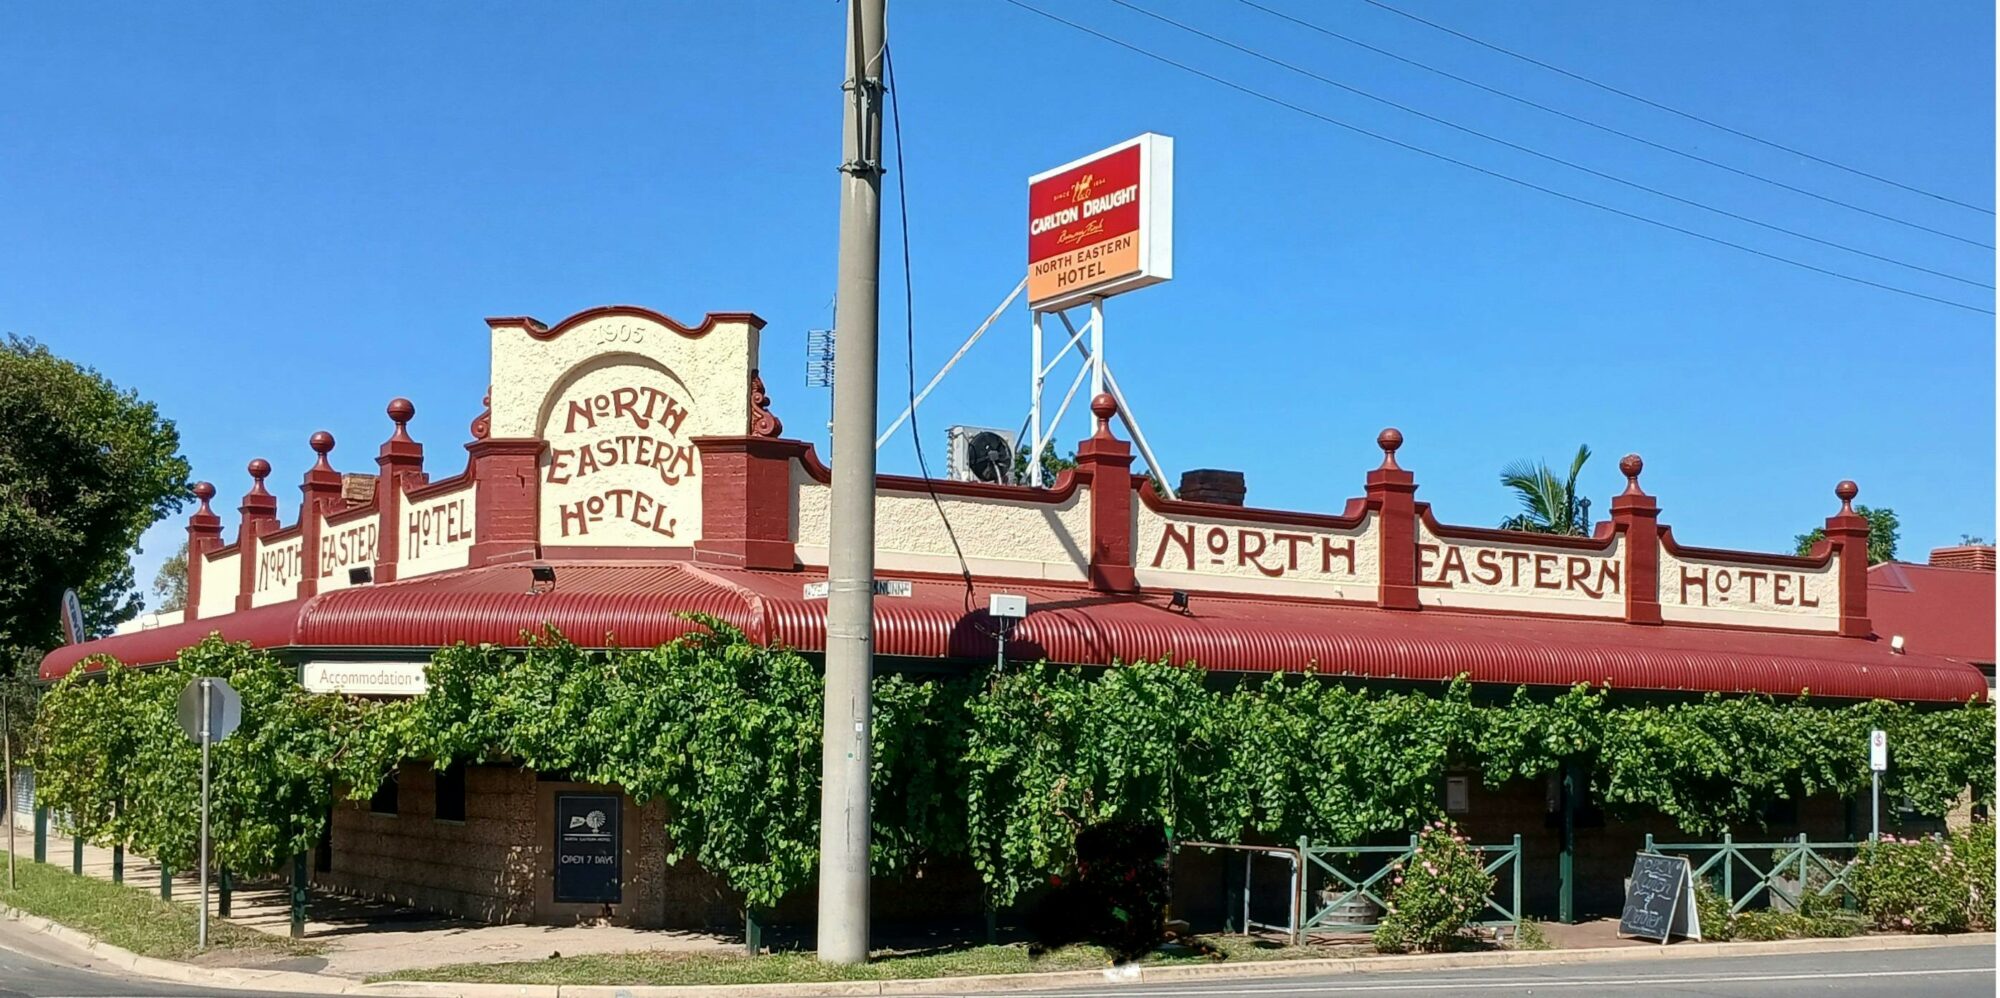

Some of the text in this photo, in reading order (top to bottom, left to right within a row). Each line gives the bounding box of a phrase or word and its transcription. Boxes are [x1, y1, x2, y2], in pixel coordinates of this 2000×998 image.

[1030, 184, 1138, 236] CARLTON DRAUGHT
[1035, 236, 1131, 276] NORTH EASTERN
[1057, 261, 1105, 287] HOTEL
[592, 323, 646, 346] 1905
[564, 386, 689, 438] NORTH
[546, 435, 696, 486] EASTERN
[321, 523, 380, 577] EASTER
[408, 499, 472, 560] HOTEL
[559, 489, 677, 538] HOTEL
[1151, 523, 1820, 607] NORTH EASTERN HOTEL
[319, 669, 412, 685] Accommodation
[561, 855, 613, 864] OPEN 7 DAYS
